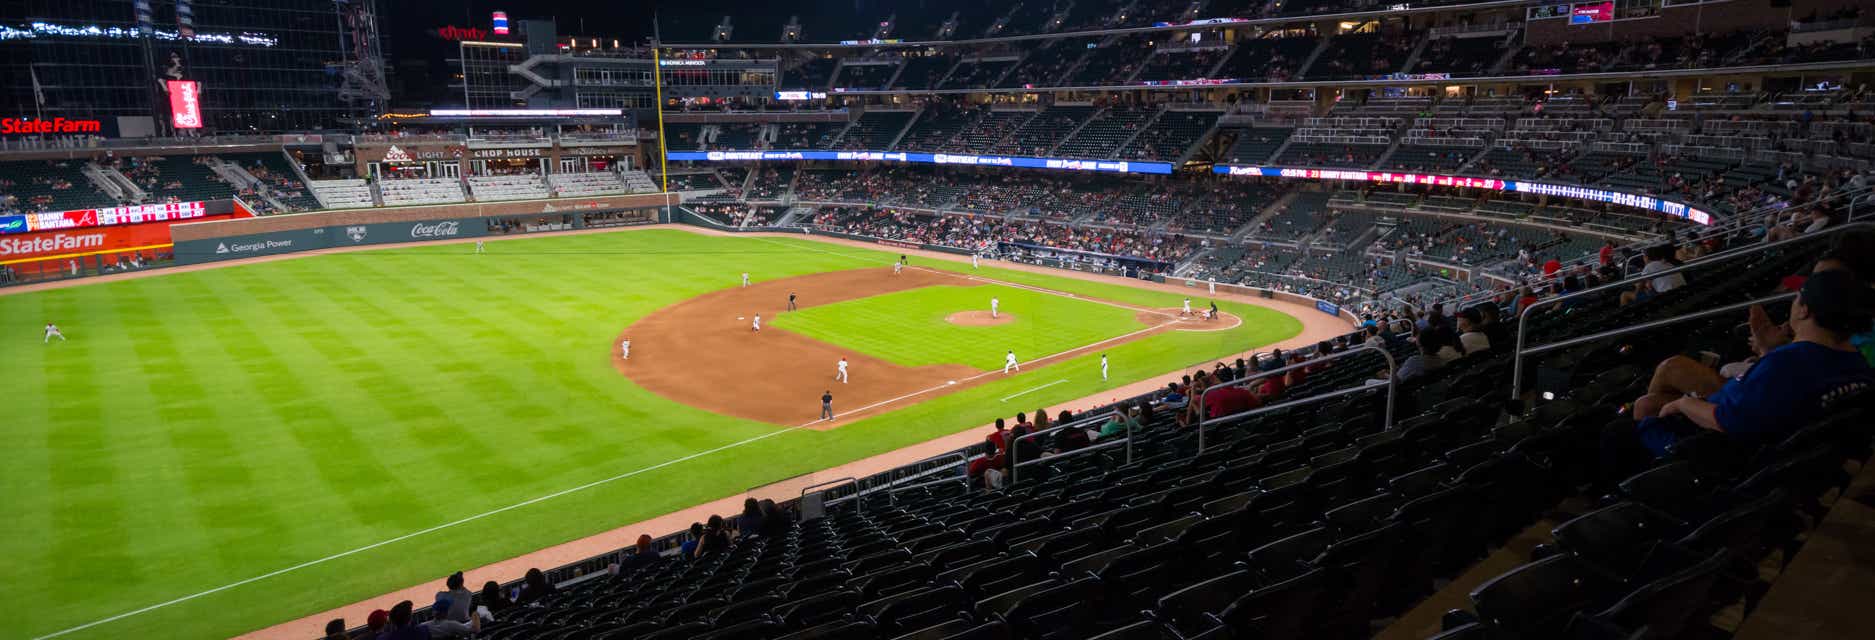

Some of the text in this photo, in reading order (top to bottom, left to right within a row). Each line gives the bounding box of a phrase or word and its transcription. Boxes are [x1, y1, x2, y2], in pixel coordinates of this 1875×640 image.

[416, 151, 445, 160] LIGHT
[474, 149, 541, 158] CHOP HOUSE
[411, 221, 459, 238] Coca-Cola
[231, 239, 292, 253] Georgia Power
